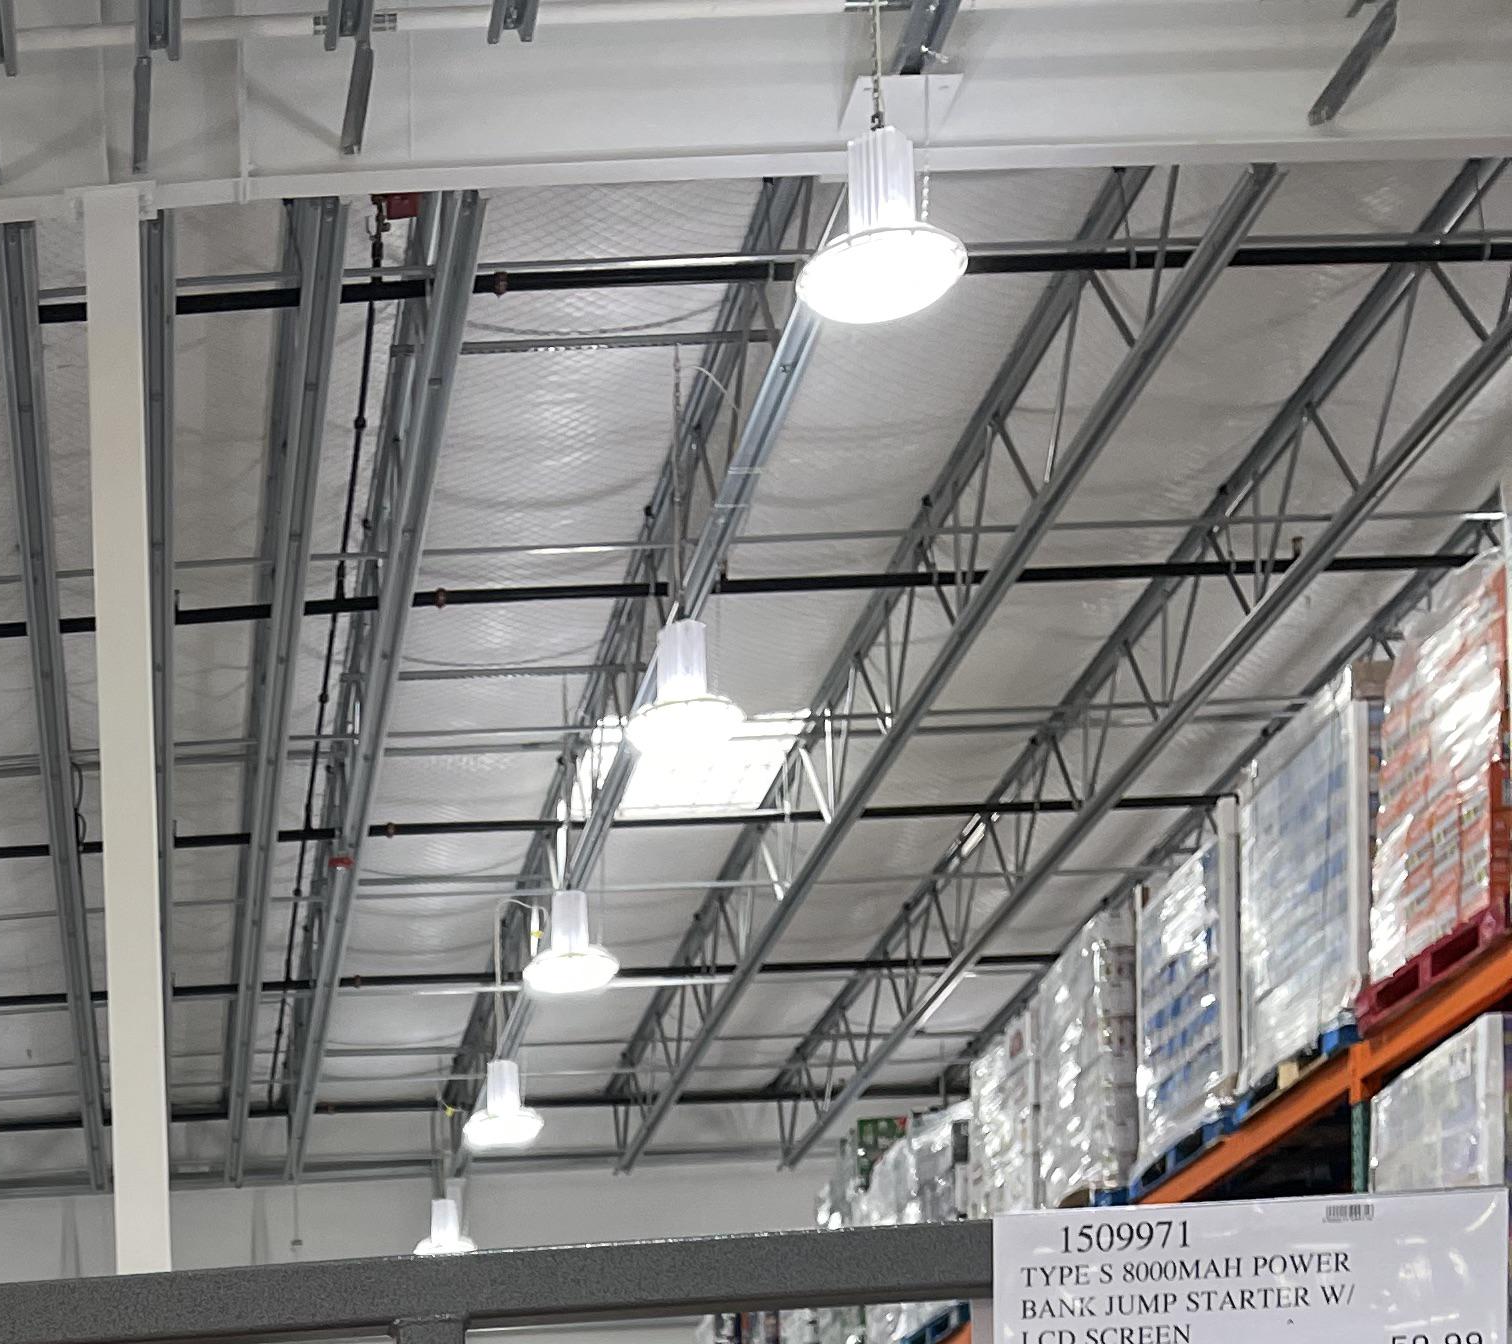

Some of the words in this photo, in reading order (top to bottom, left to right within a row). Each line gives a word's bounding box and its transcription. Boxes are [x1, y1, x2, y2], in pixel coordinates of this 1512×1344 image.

[1062, 1220, 1191, 1254] 1509971
[1021, 1264, 1090, 1288] TYPE
[1099, 1263, 1114, 1284] S
[1122, 1257, 1242, 1283] 8000MAH
[1253, 1252, 1351, 1277] POWER
[1021, 1295, 1096, 1320] BANK
[1105, 1293, 1177, 1316] JUMP
[1186, 1287, 1311, 1312] STARTER
[1320, 1284, 1355, 1306] W/
